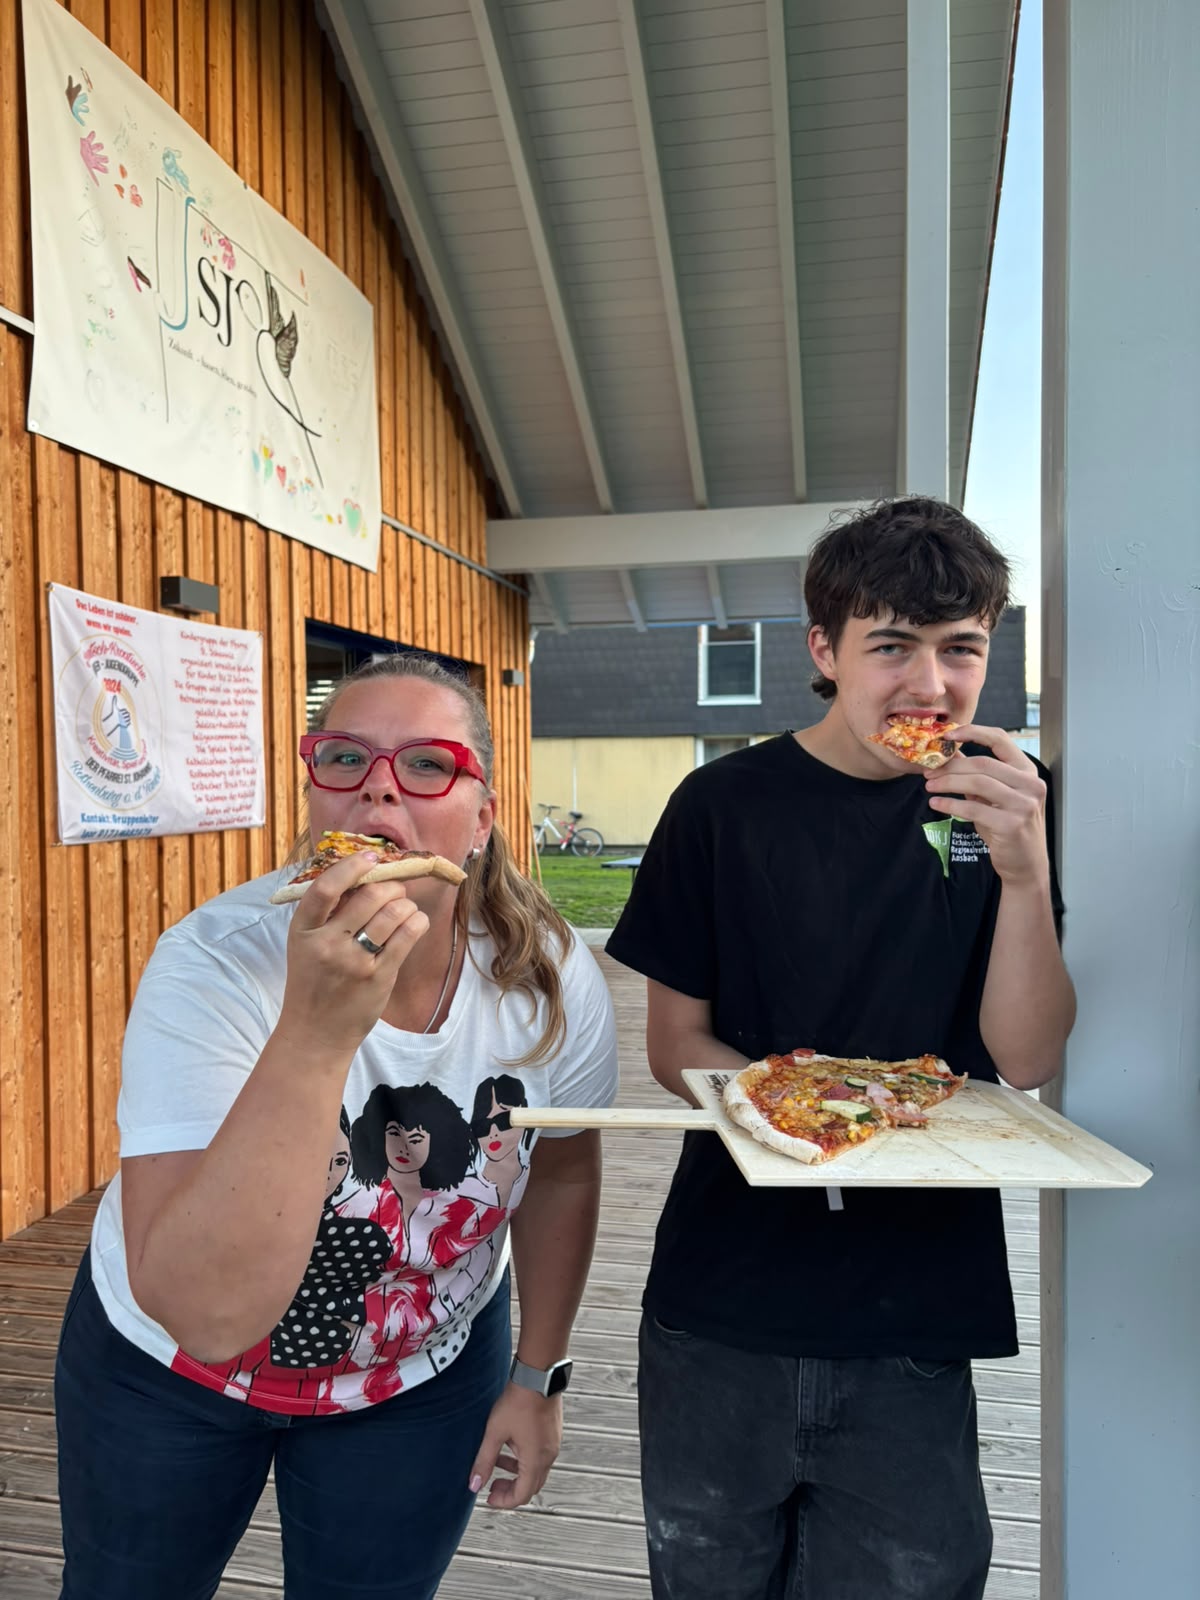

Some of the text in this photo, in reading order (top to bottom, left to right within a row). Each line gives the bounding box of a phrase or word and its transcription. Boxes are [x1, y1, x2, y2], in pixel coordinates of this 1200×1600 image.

[88, 602, 106, 615] Leben
[85, 756, 100, 773] DER
[97, 766, 123, 784] PFARREI
[952, 854, 978, 862] Ansbach
